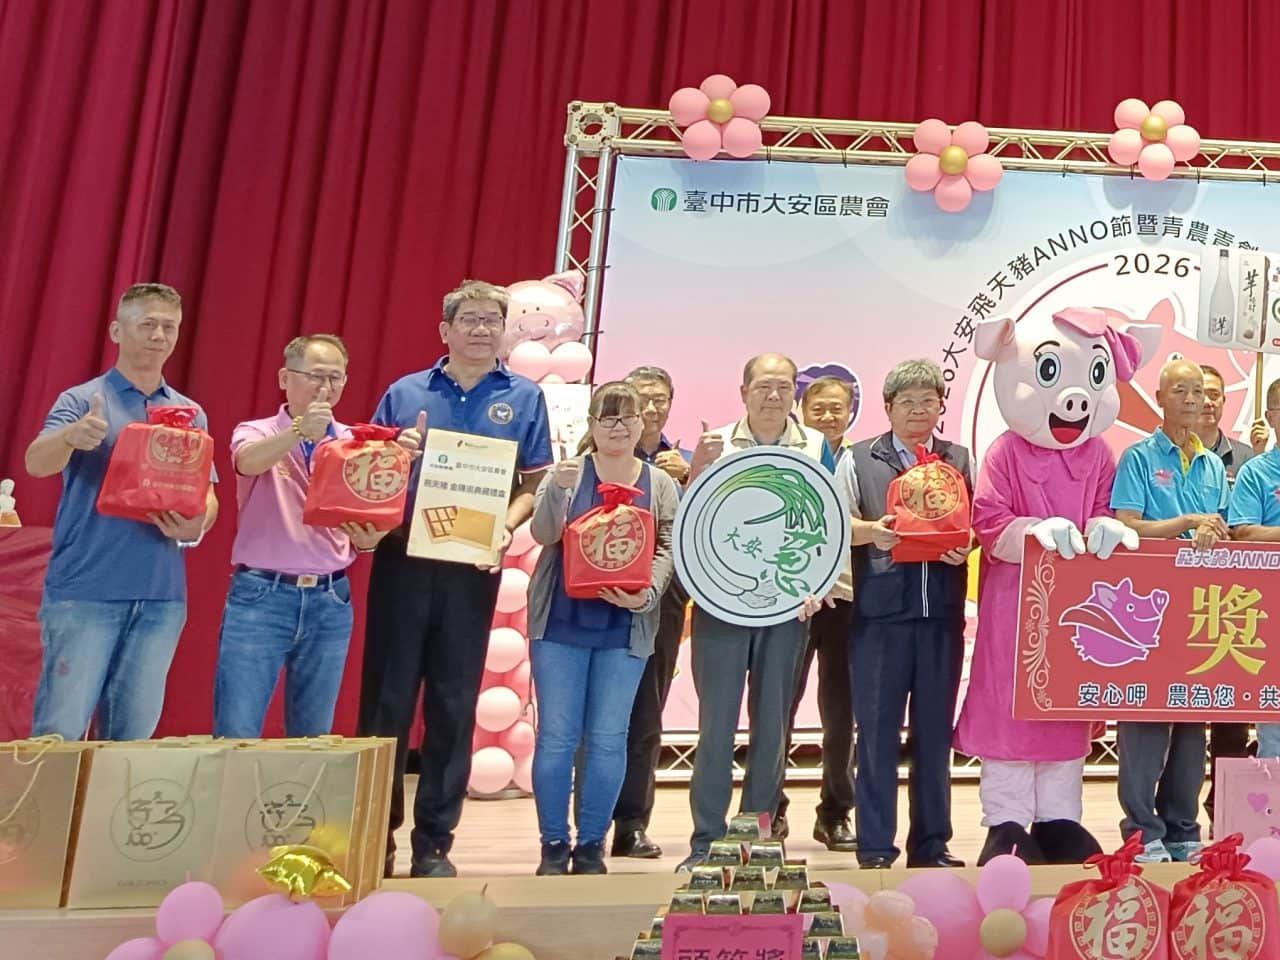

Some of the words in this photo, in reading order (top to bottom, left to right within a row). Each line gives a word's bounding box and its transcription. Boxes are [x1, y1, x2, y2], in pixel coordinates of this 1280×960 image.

[683, 189, 890, 218] 臺中市大安區農會
[1115, 252, 1191, 279] 2026
[1184, 583, 1270, 676] 獎
[1077, 683, 1148, 707] 安心呷
[1082, 881, 1150, 960] 福
[1182, 889, 1257, 960] 福
